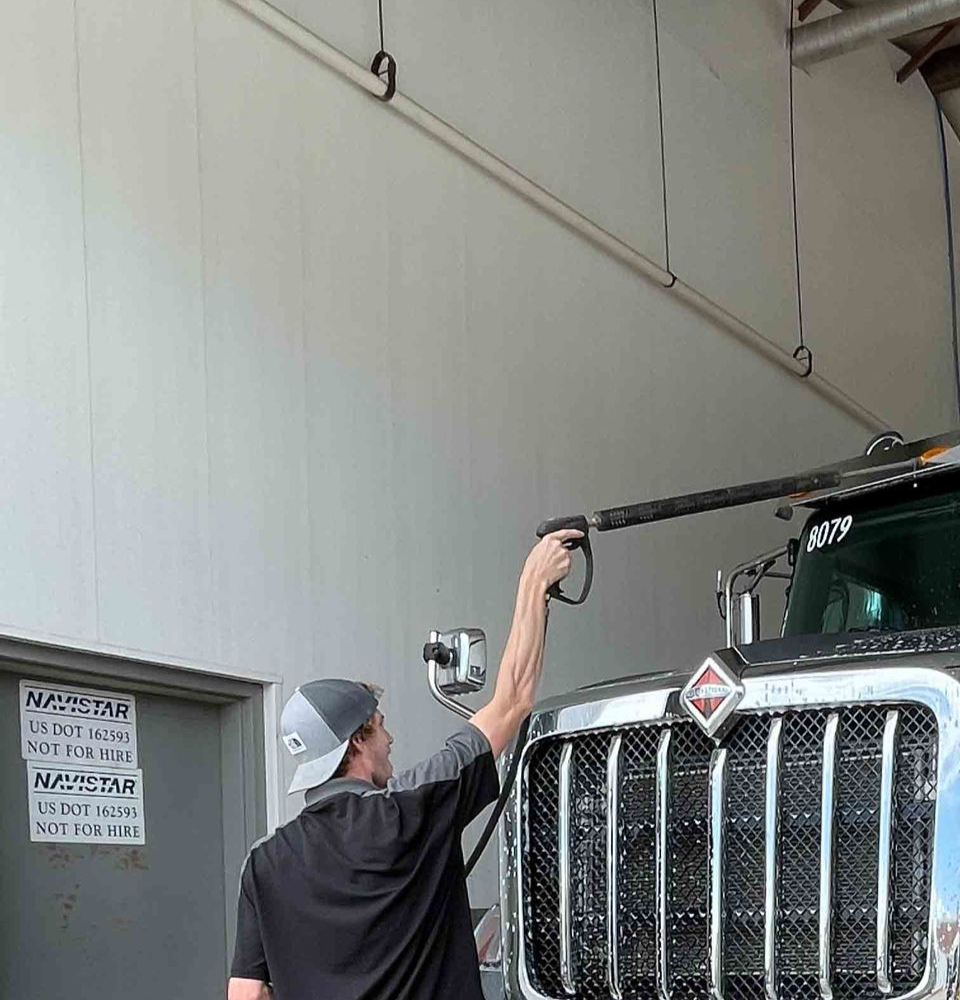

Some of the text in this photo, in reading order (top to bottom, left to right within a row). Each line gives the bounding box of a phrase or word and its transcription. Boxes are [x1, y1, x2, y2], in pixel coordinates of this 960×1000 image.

[807, 515, 853, 552] 8079
[26, 691, 129, 719] NAVISTAR
[29, 720, 130, 743] US DOT 162593
[28, 740, 133, 763] NOT FOR HIRE
[34, 772, 136, 794] NAVISTAR
[38, 802, 137, 819] US DOT 162593
[36, 821, 140, 838] NOT FOR HIRE
